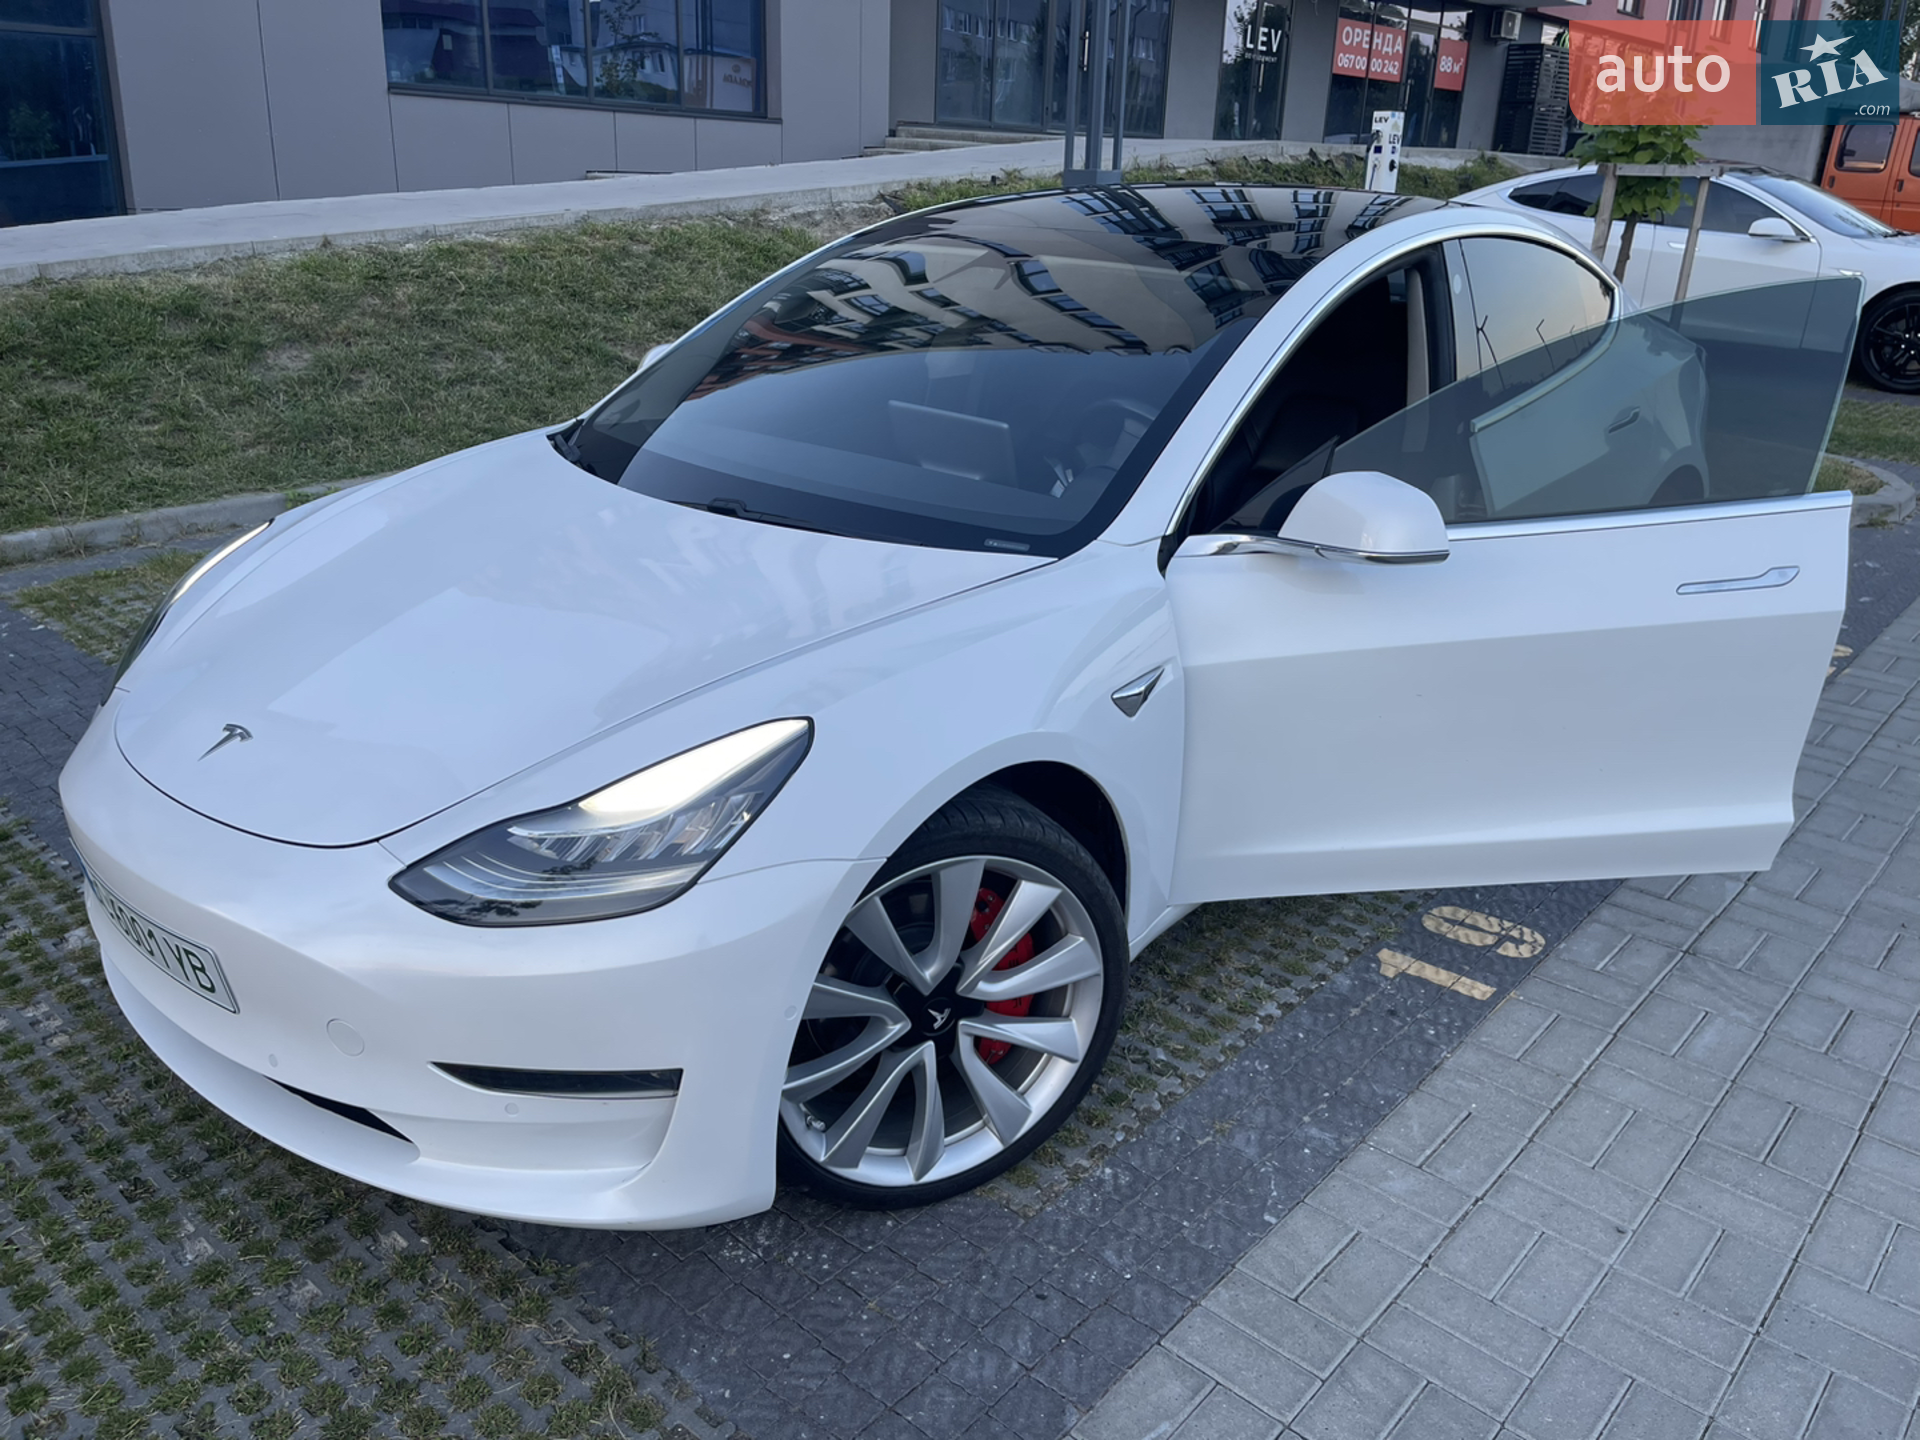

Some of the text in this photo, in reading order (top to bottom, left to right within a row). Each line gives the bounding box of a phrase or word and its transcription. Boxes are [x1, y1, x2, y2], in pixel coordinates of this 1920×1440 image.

[1246, 25, 1282, 53] LEV
[1342, 26, 1403, 56] ОРЕНДА
[1374, 116, 1389, 124] LEV
